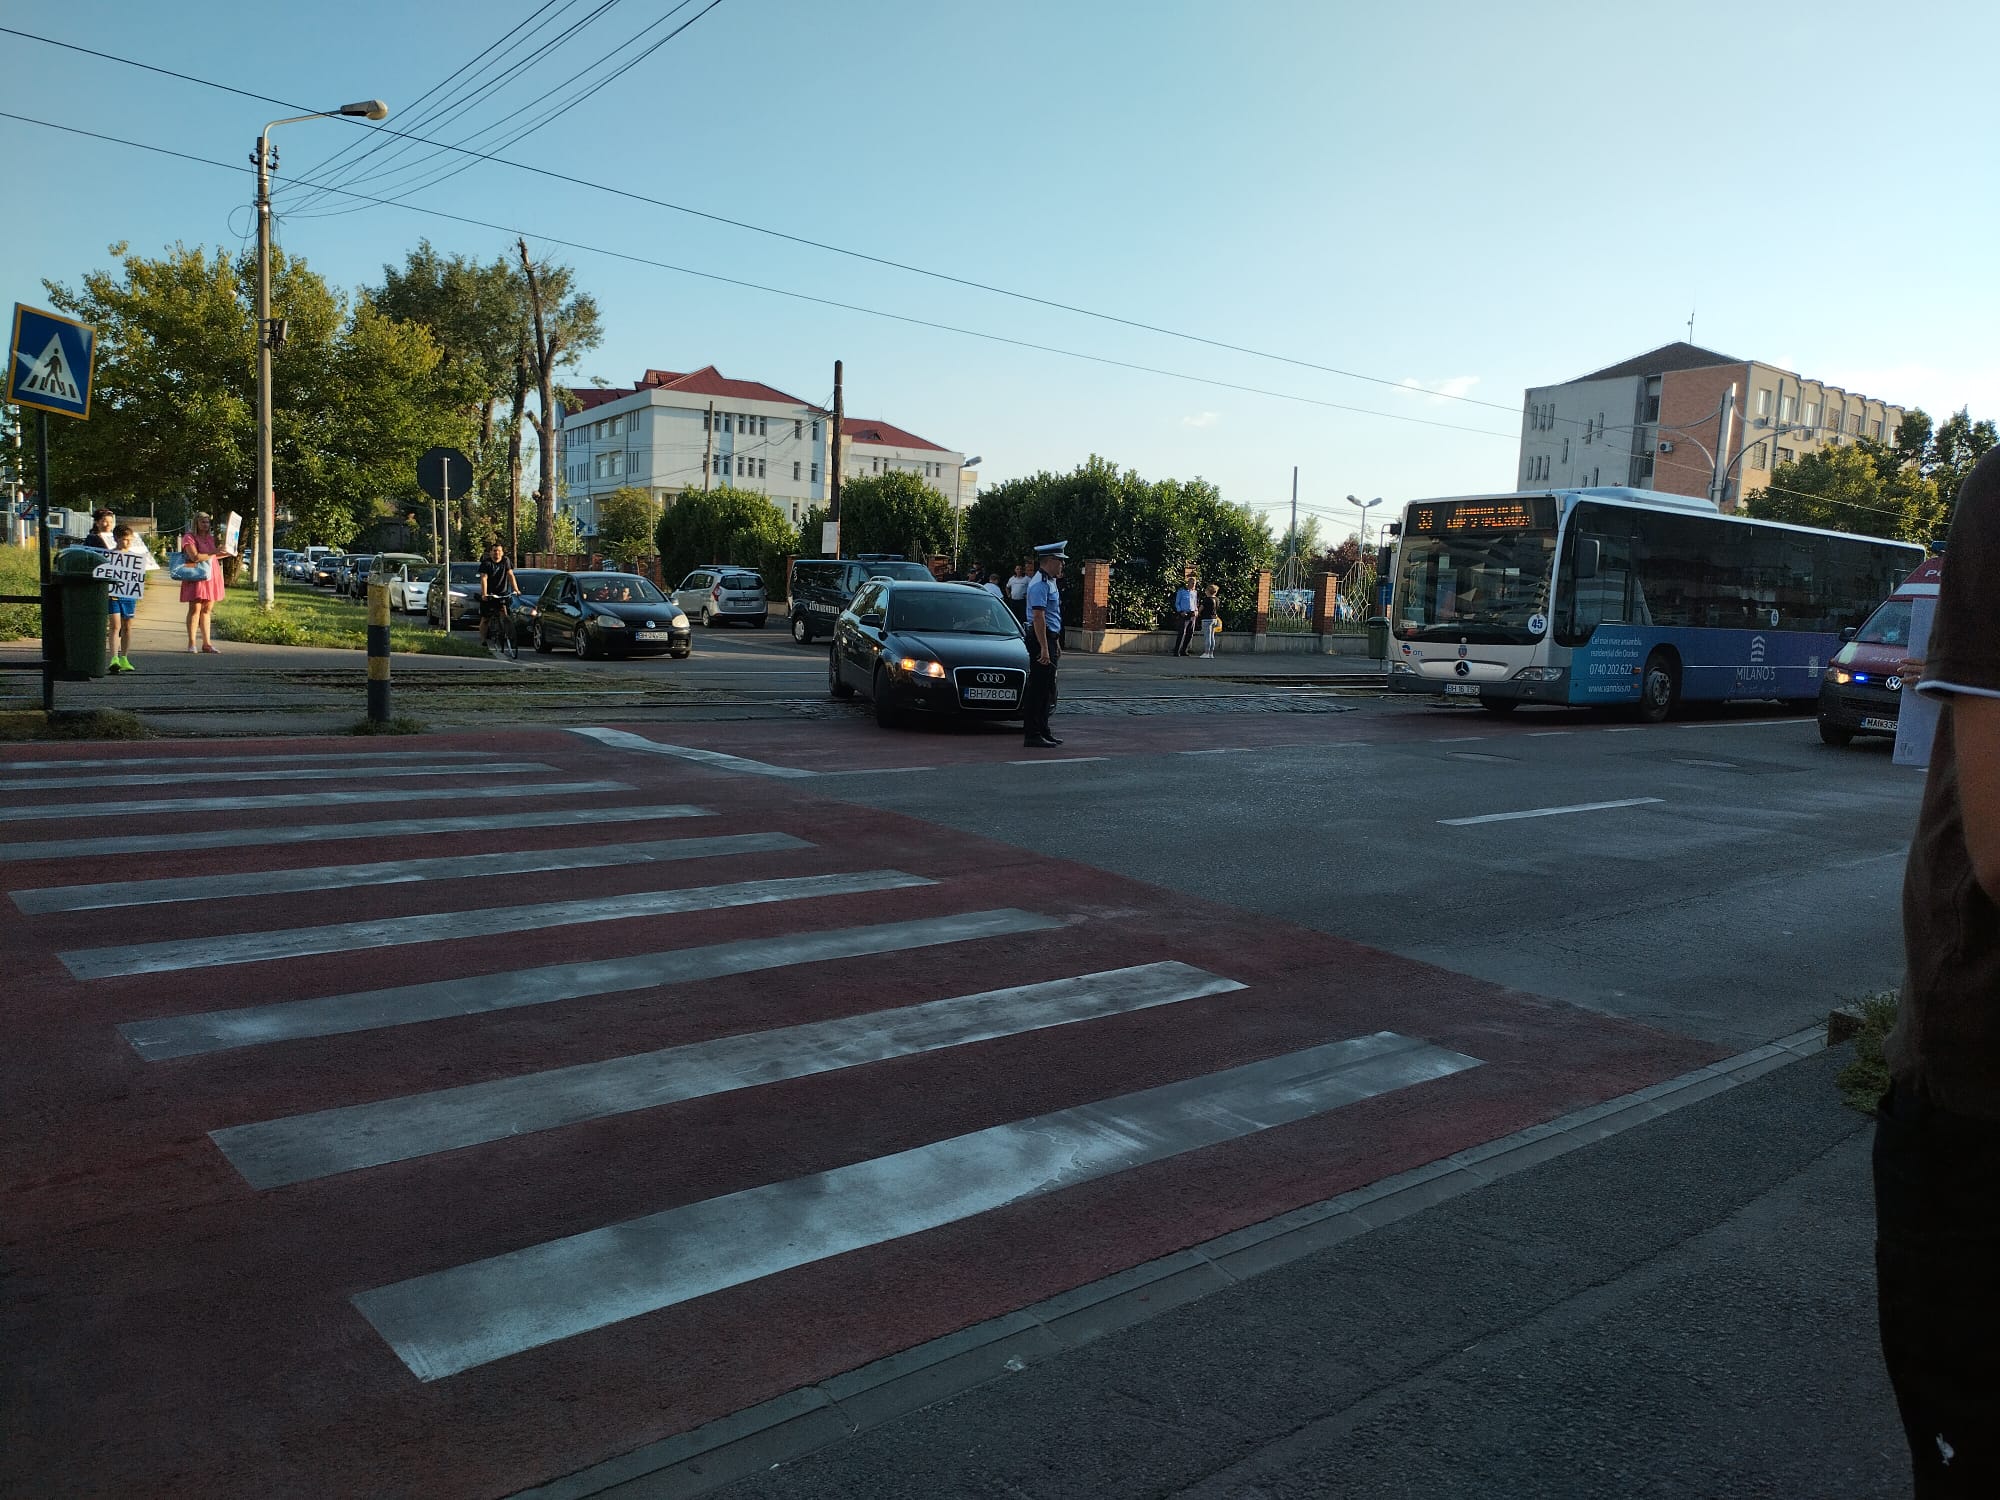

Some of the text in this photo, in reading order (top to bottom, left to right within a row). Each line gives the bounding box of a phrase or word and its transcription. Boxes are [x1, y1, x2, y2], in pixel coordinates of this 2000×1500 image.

[96, 567, 146, 583] PENTRU
[1531, 618, 1543, 629] 45
[1589, 663, 1633, 675] 0740 202 622
[1736, 667, 1776, 681] MILANO 5
[969, 688, 1016, 699] BH 78 CCA
[1883, 720, 1898, 730] 335
